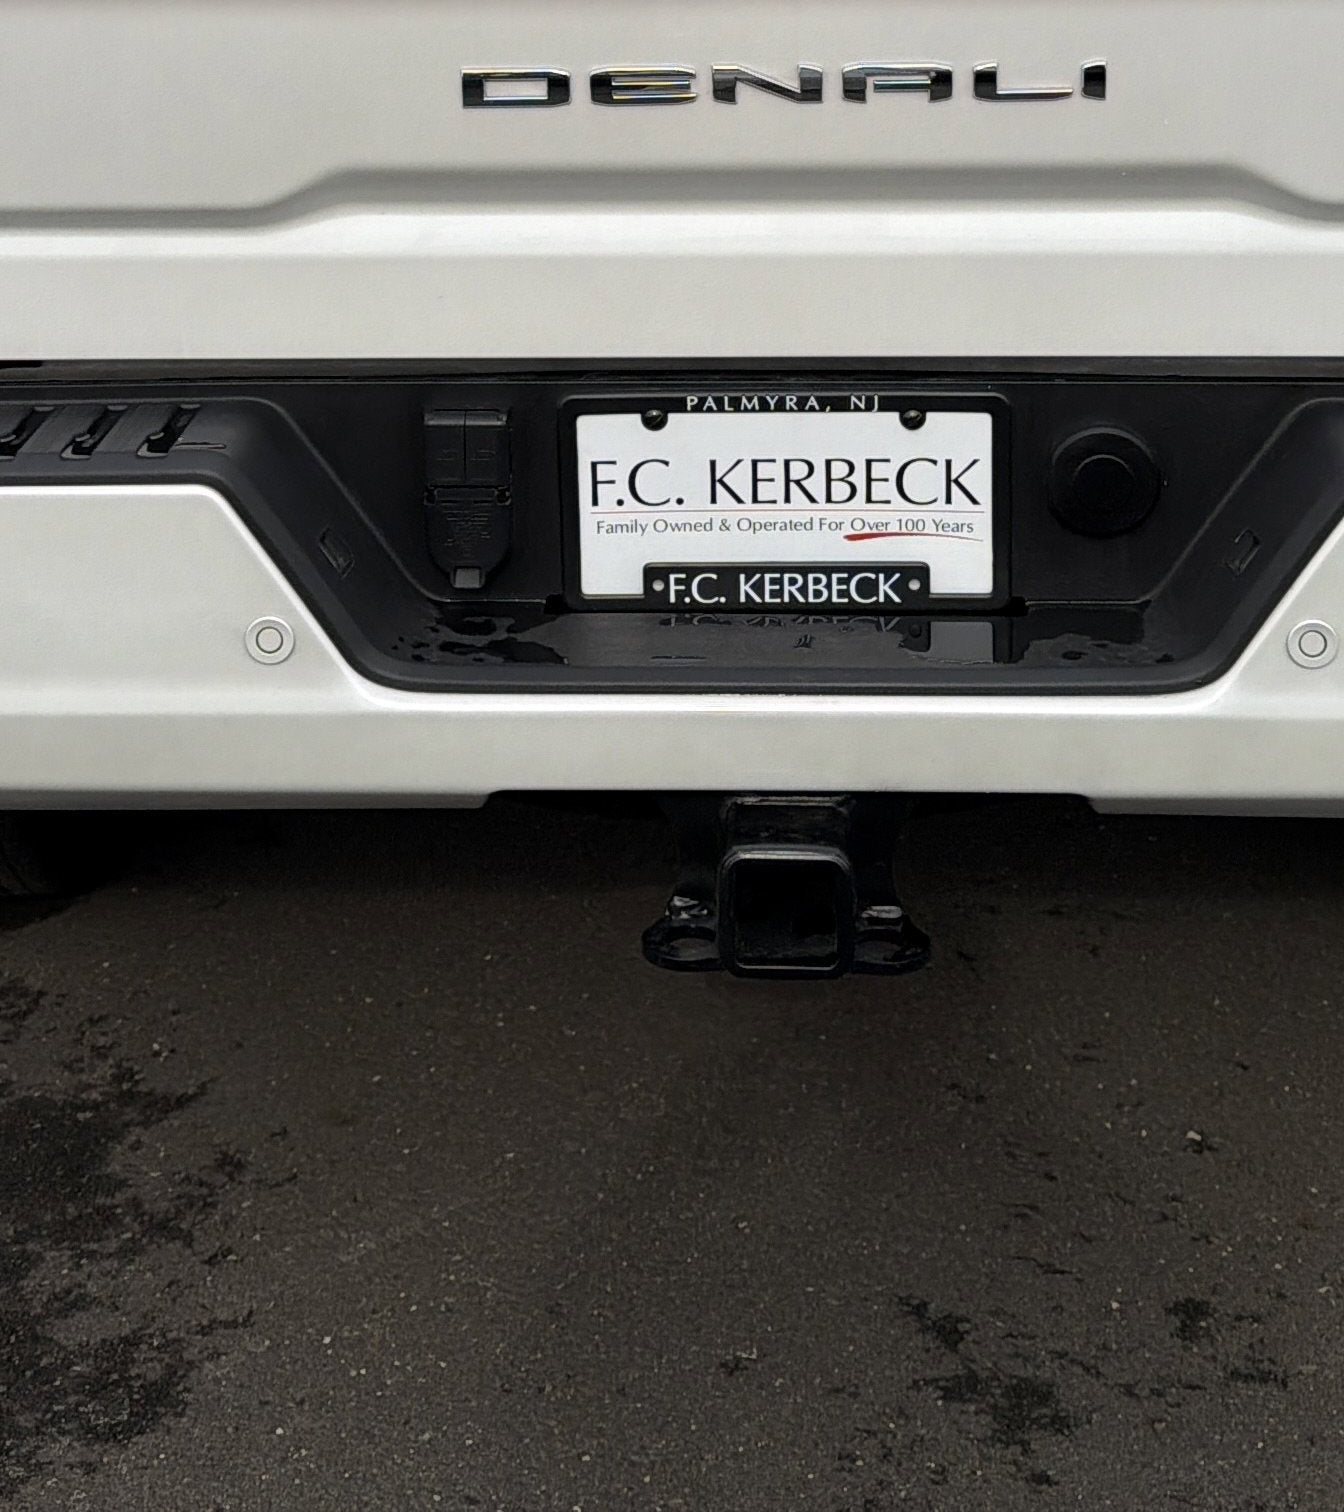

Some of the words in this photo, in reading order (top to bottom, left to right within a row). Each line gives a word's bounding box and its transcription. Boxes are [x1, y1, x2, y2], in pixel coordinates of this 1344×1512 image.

[461, 61, 1107, 108] DENALI
[686, 395, 832, 412] PALMYRA,
[850, 395, 880, 412] NJ
[590, 458, 686, 507] F.C.
[709, 458, 982, 506] KERBECK
[596, 520, 649, 536] Family
[653, 518, 713, 534] Owned
[718, 518, 731, 534] &
[737, 517, 814, 536] Operated
[818, 517, 844, 532] For
[850, 518, 890, 533] Over
[896, 518, 926, 533] 100
[932, 518, 974, 534] Years
[668, 575, 727, 604] F.C.
[739, 573, 902, 604] KERBECK
